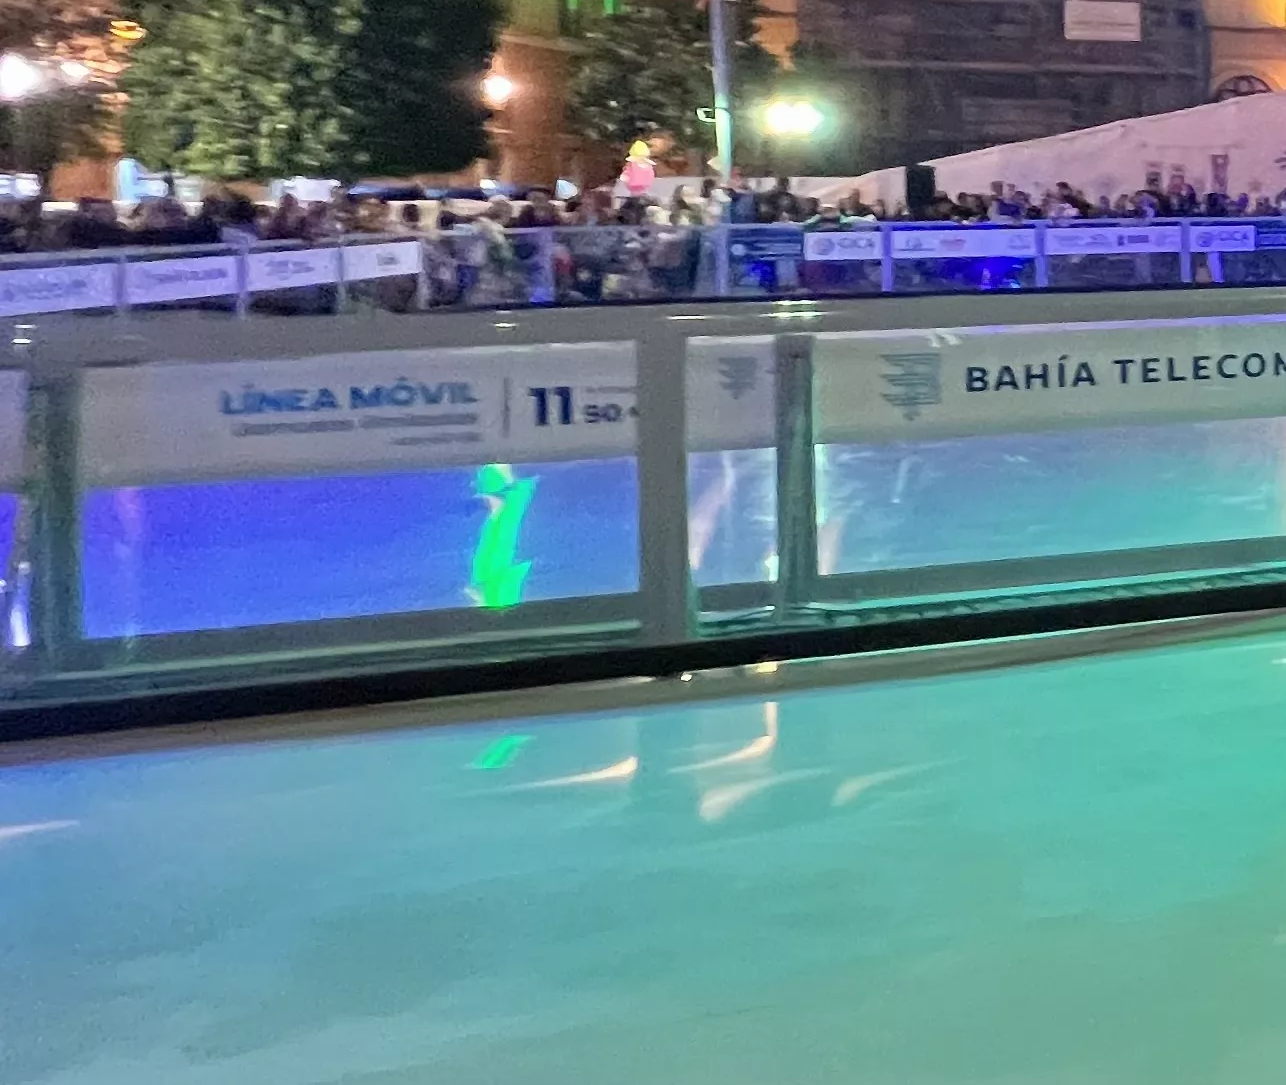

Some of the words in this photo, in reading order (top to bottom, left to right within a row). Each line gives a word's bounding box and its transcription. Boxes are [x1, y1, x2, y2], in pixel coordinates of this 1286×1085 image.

[965, 354, 1097, 393] BAHÍA
[220, 382, 338, 415] LÍNEA
[349, 375, 478, 409] MÓVIL
[527, 385, 573, 427] 11
